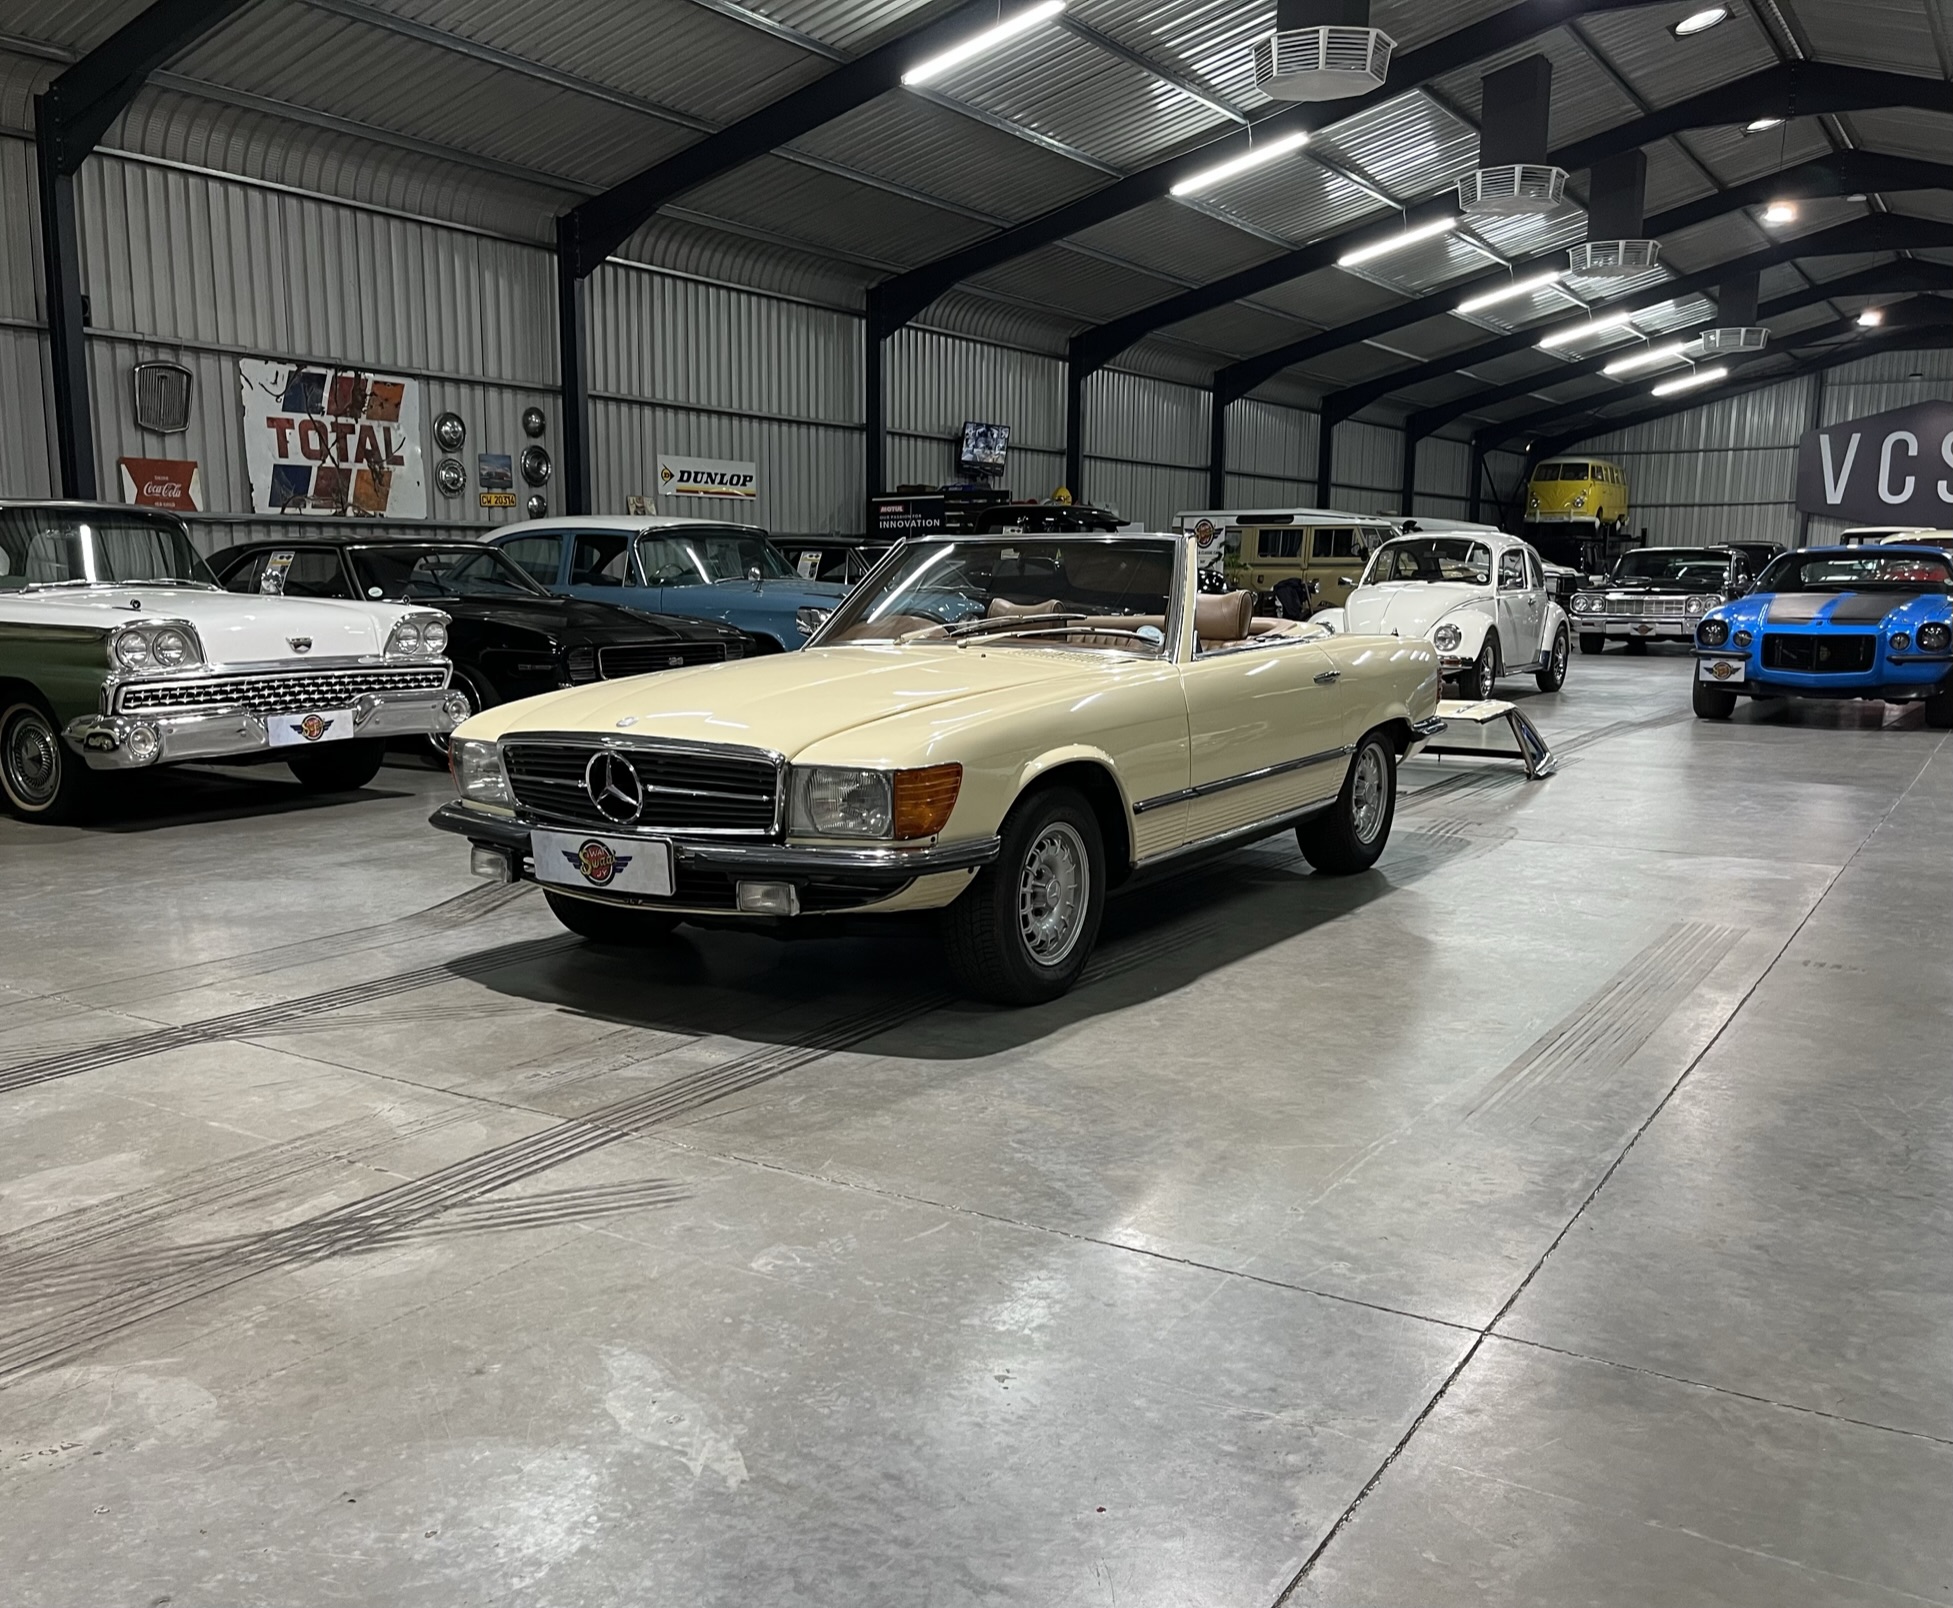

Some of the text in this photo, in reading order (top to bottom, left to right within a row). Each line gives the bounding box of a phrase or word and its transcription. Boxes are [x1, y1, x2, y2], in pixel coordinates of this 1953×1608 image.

[266, 416, 405, 466] TOTAL
[677, 470, 754, 487] DUNLOP
[481, 496, 515, 505] CW 20314
[880, 505, 904, 513] MOTUL
[879, 519, 940, 529] INNOVATION
